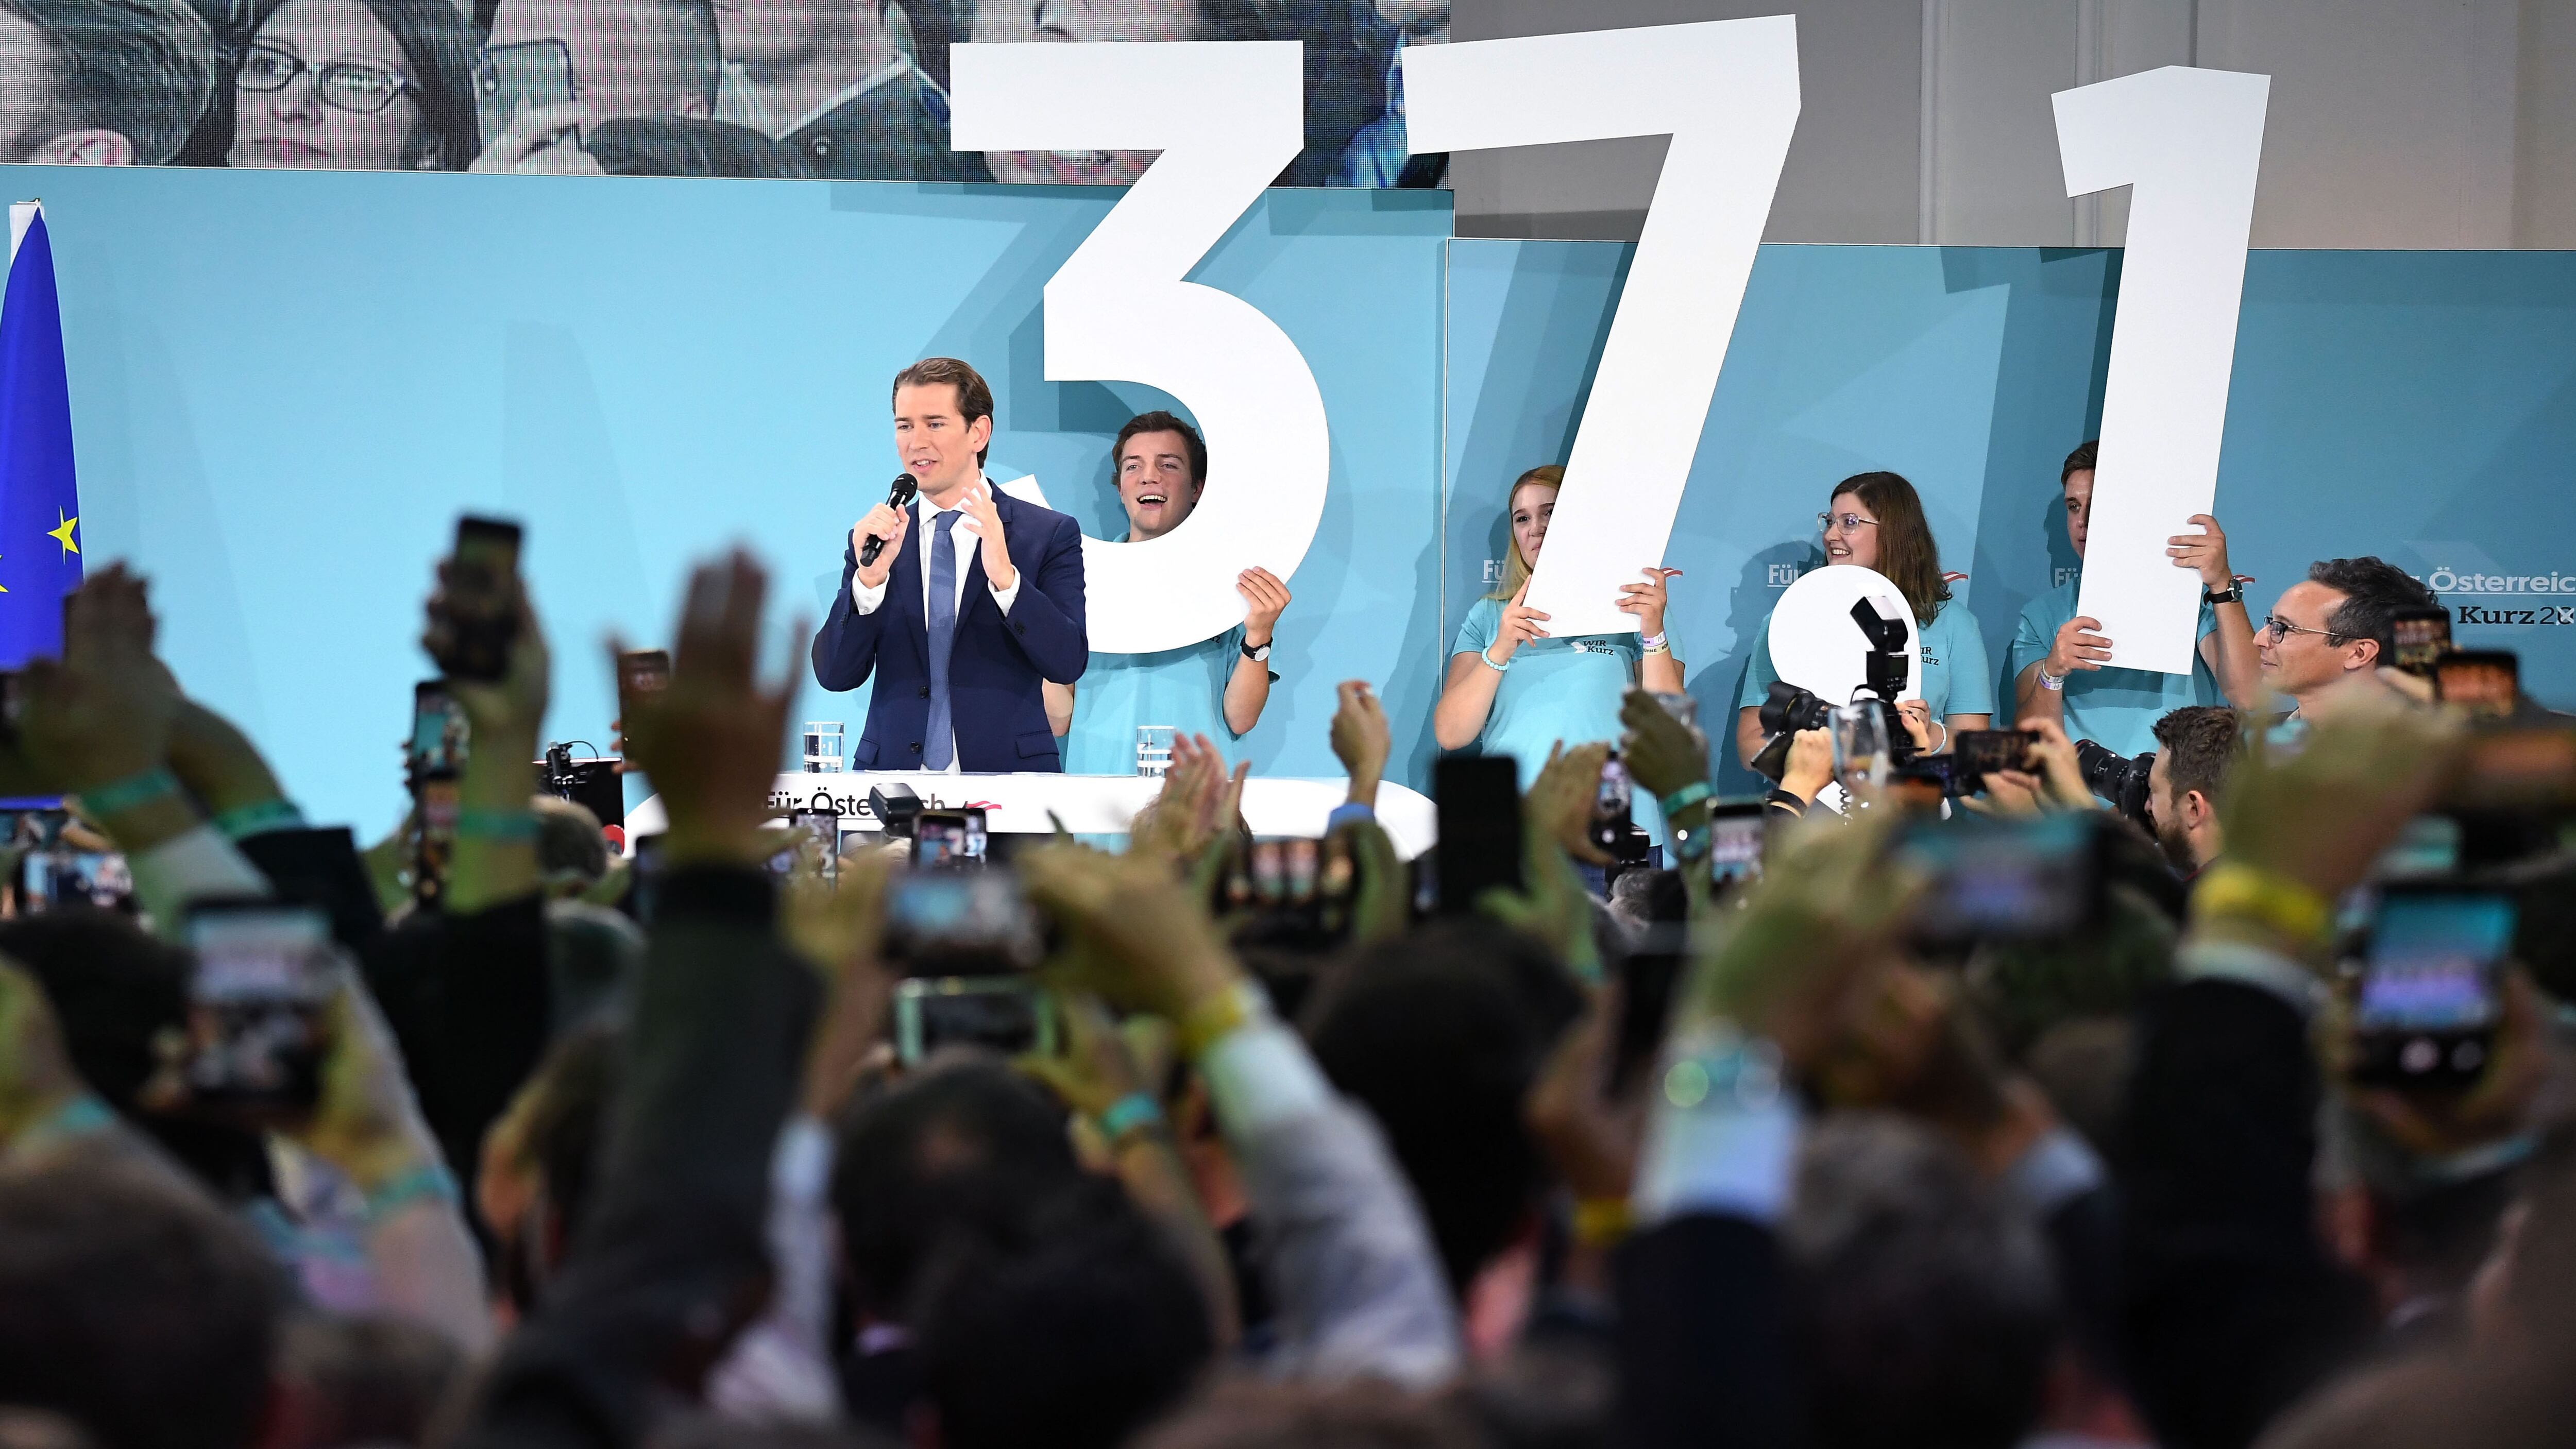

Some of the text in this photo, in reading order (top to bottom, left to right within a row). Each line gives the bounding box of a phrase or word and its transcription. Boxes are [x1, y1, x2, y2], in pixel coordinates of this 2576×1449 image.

[1483, 559, 1505, 581] Fü
[2458, 606, 2534, 625] Kurz
[1587, 646, 1614, 656] Kurz
[1920, 646, 1932, 655] IR
[1921, 655, 1939, 666] urz
